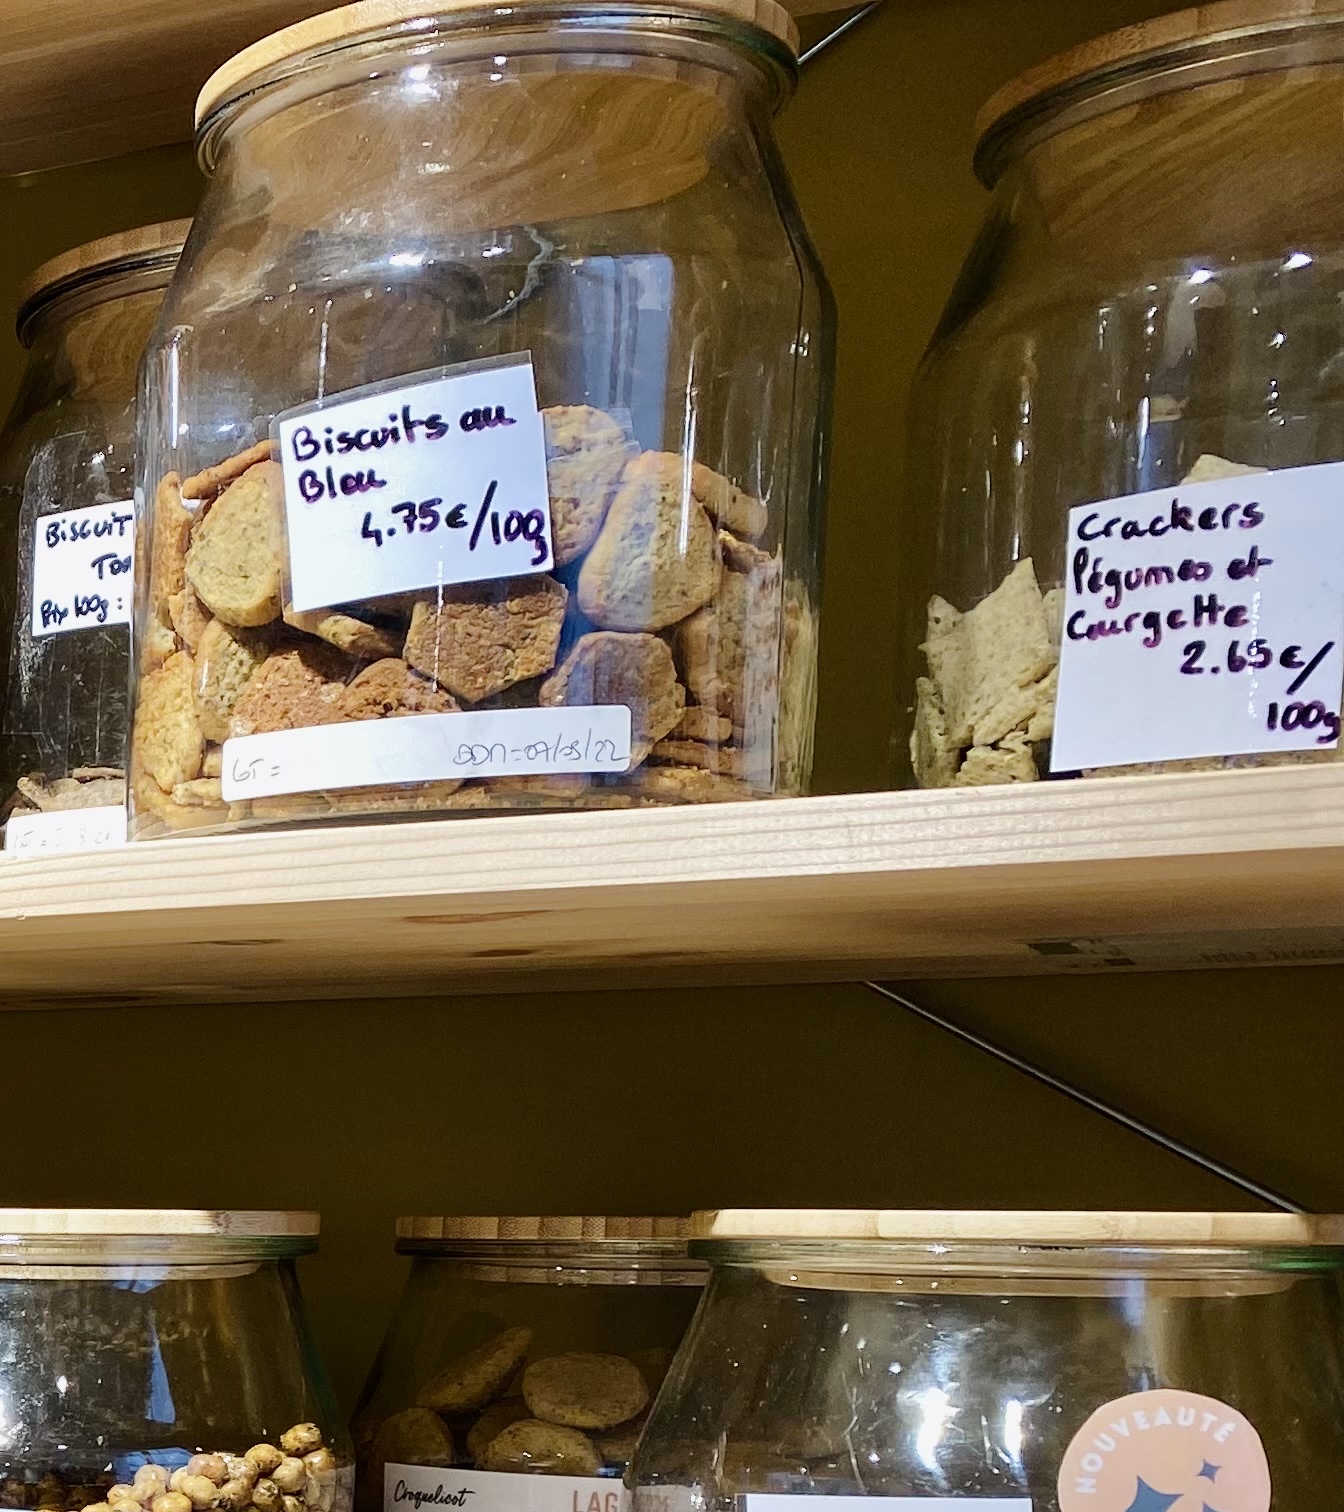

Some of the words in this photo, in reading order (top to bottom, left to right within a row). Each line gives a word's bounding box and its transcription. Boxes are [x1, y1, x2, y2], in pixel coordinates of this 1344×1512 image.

[292, 405, 449, 462] Biscuits
[460, 406, 516, 432] au
[299, 466, 386, 502] Bleu
[1077, 498, 1264, 540] Crackers
[1227, 545, 1273, 580] et
[1267, 700, 1341, 744] 100g
[1076, 1407, 1237, 1495] NOUVEAUTÉ
[394, 1480, 476, 1509] Croquelicot
